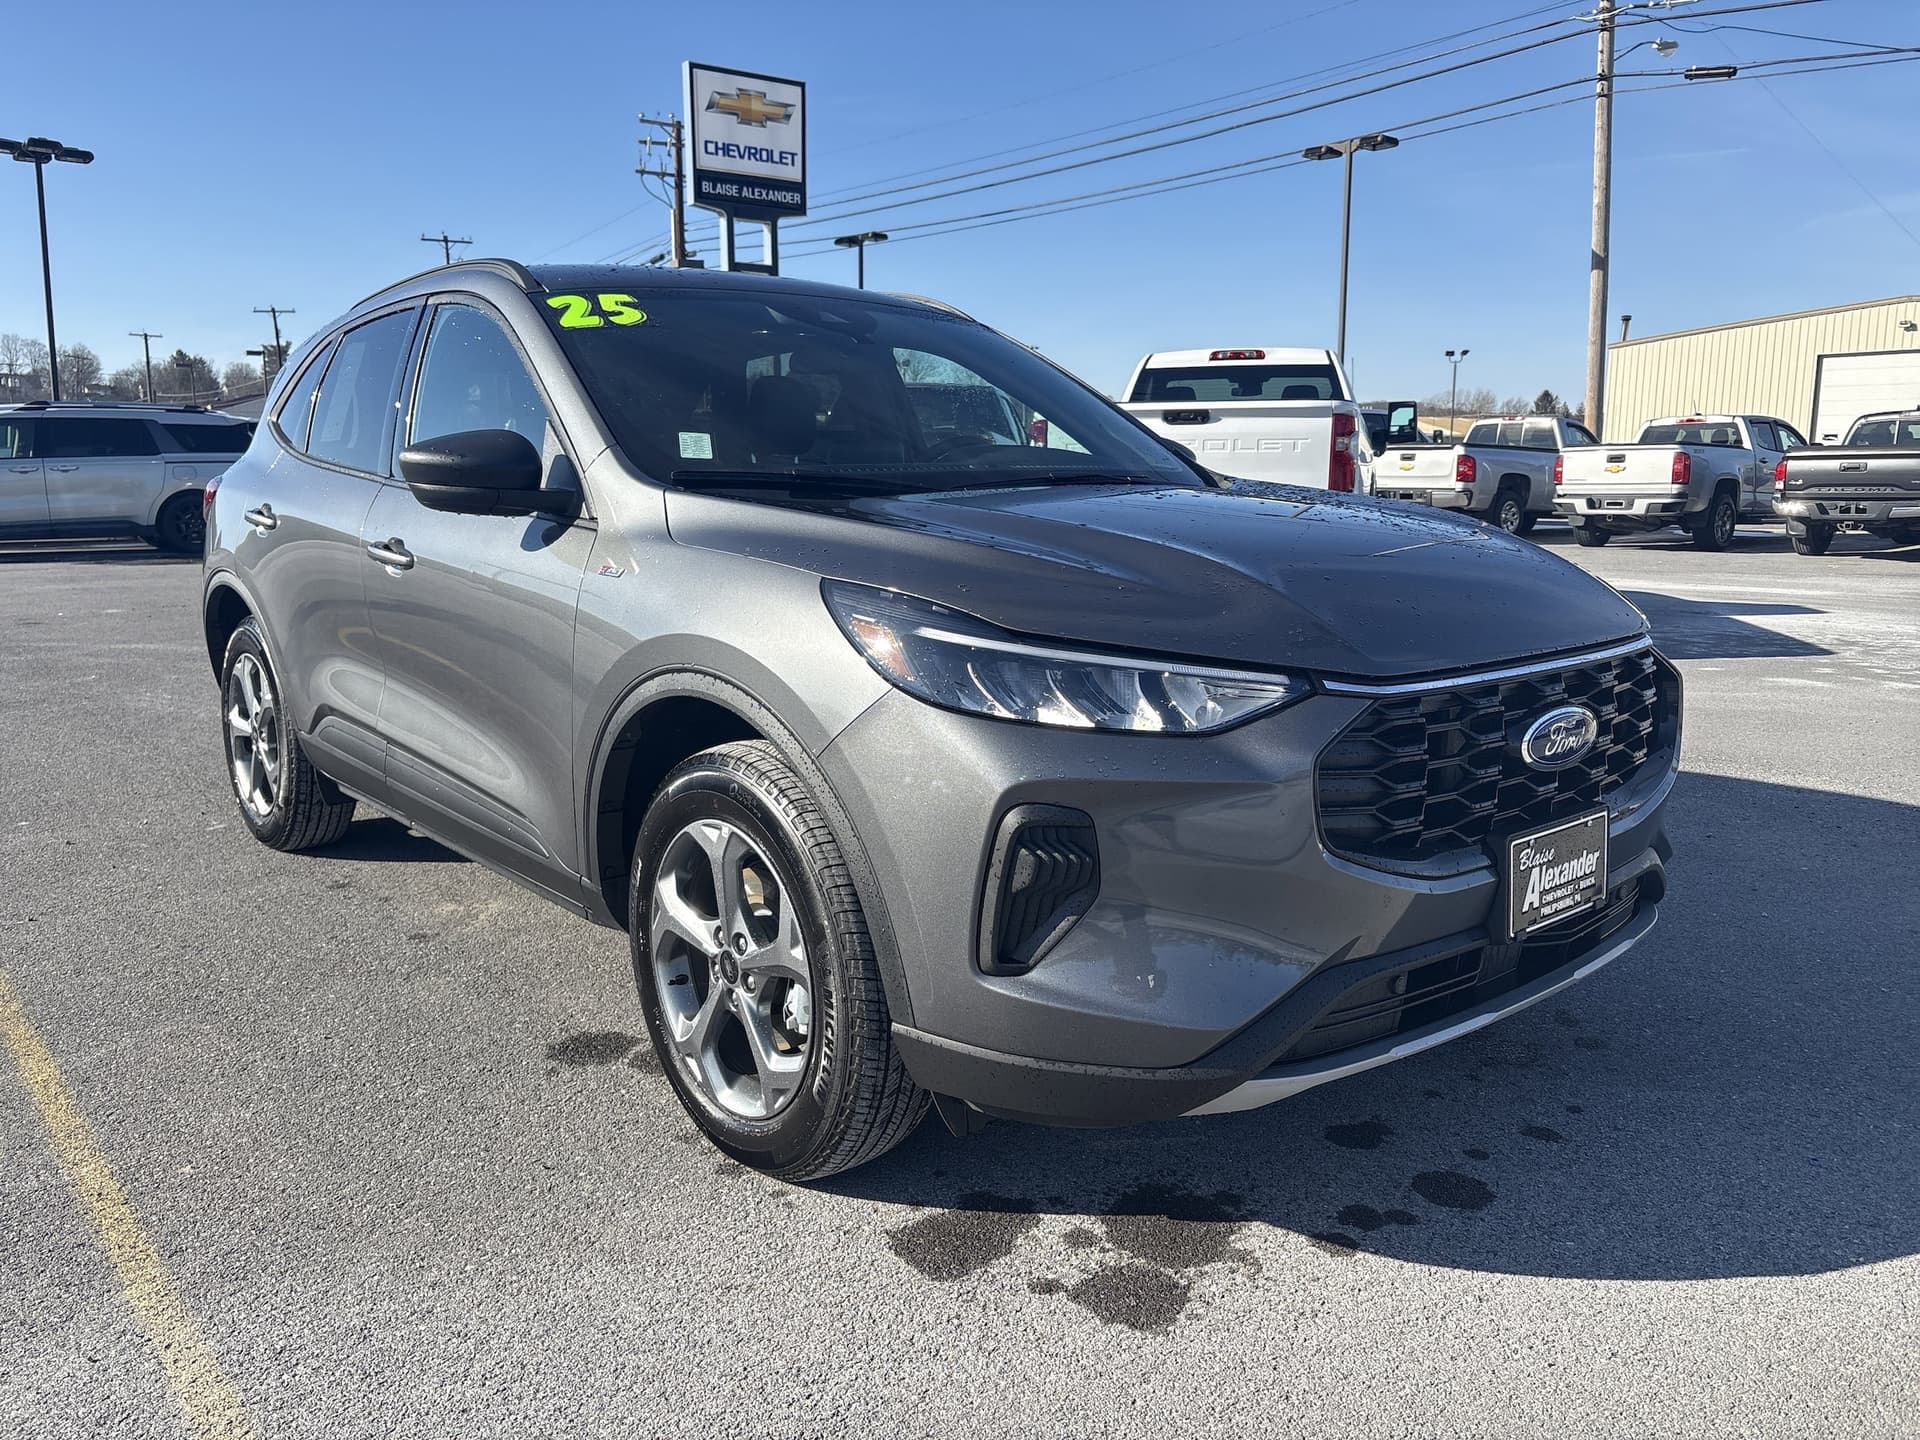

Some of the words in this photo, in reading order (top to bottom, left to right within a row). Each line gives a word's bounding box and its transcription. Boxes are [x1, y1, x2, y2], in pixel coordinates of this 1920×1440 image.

[704, 139, 798, 167] CHEVROLET
[702, 180, 739, 197] BLAISE
[741, 186, 801, 205] ALEXANDER
[546, 293, 648, 329] 25
[1815, 486, 1896, 494] TACOMA
[1545, 719, 1586, 756] Ford
[1519, 847, 1556, 871] Blaise
[1521, 849, 1600, 914] Alexander
[1541, 884, 1575, 905] CHEVROLET
[813, 985, 836, 1104] MICHELIN
